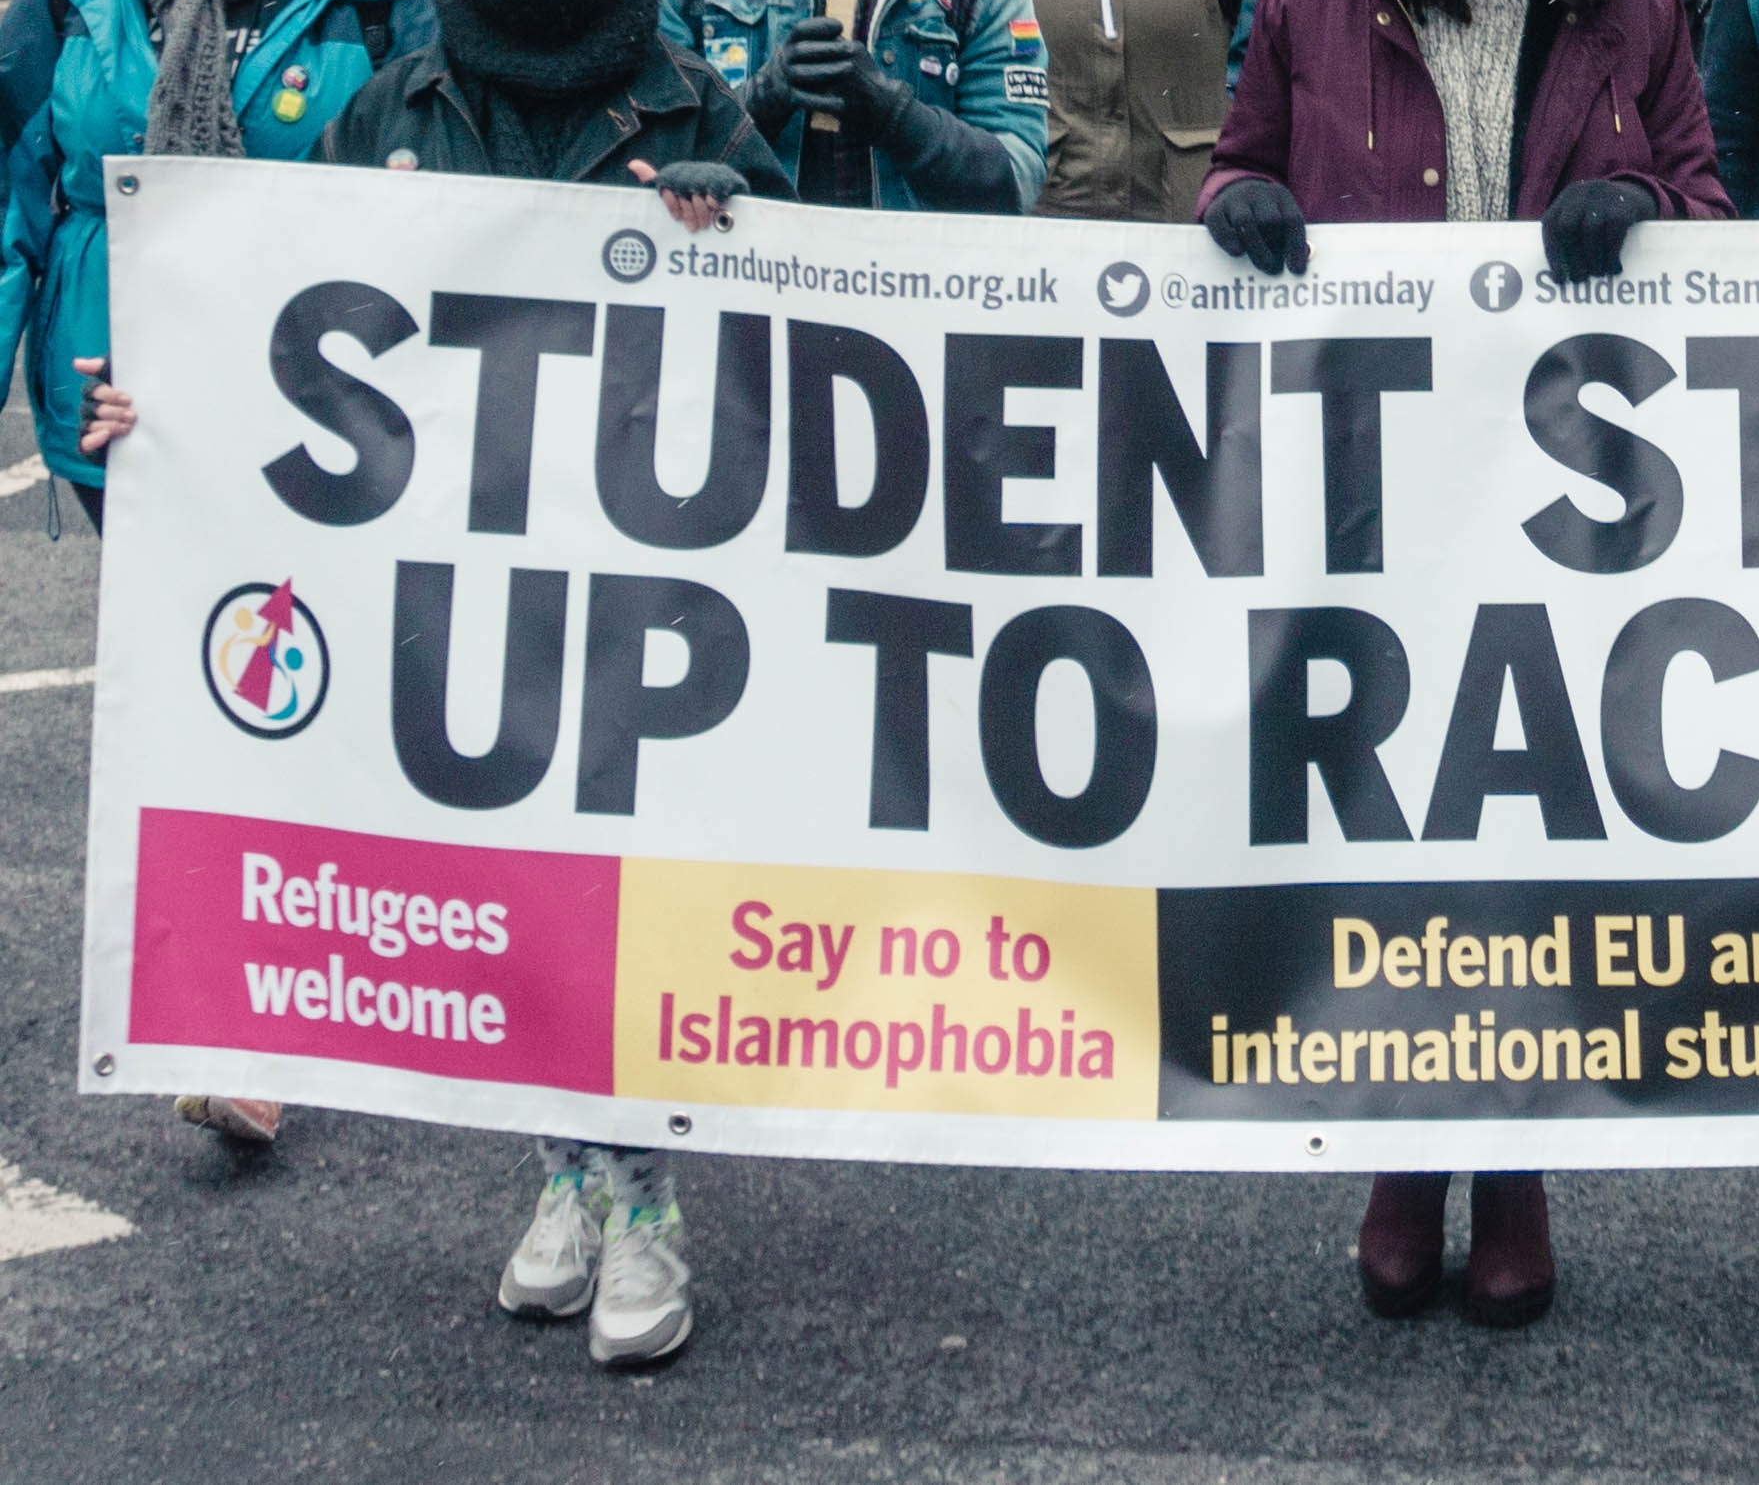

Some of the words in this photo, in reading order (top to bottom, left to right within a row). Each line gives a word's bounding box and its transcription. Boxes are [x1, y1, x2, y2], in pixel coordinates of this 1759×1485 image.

[667, 245, 1059, 313] standuptoracism.org.uk
[1160, 269, 1435, 315] @antiracismday
[261, 280, 1434, 578] STUDENT
[392, 560, 751, 816] UP
[825, 587, 1159, 849] TO
[241, 852, 508, 956] Refugees
[730, 899, 855, 992] Say
[880, 922, 962, 980] no
[984, 914, 1051, 983] to
[1332, 916, 1572, 990] Defend
[1595, 913, 1686, 987] EU
[244, 953, 507, 1048] welcome
[657, 990, 1115, 1088] Islamophobia
[1210, 1008, 1643, 1086] international
